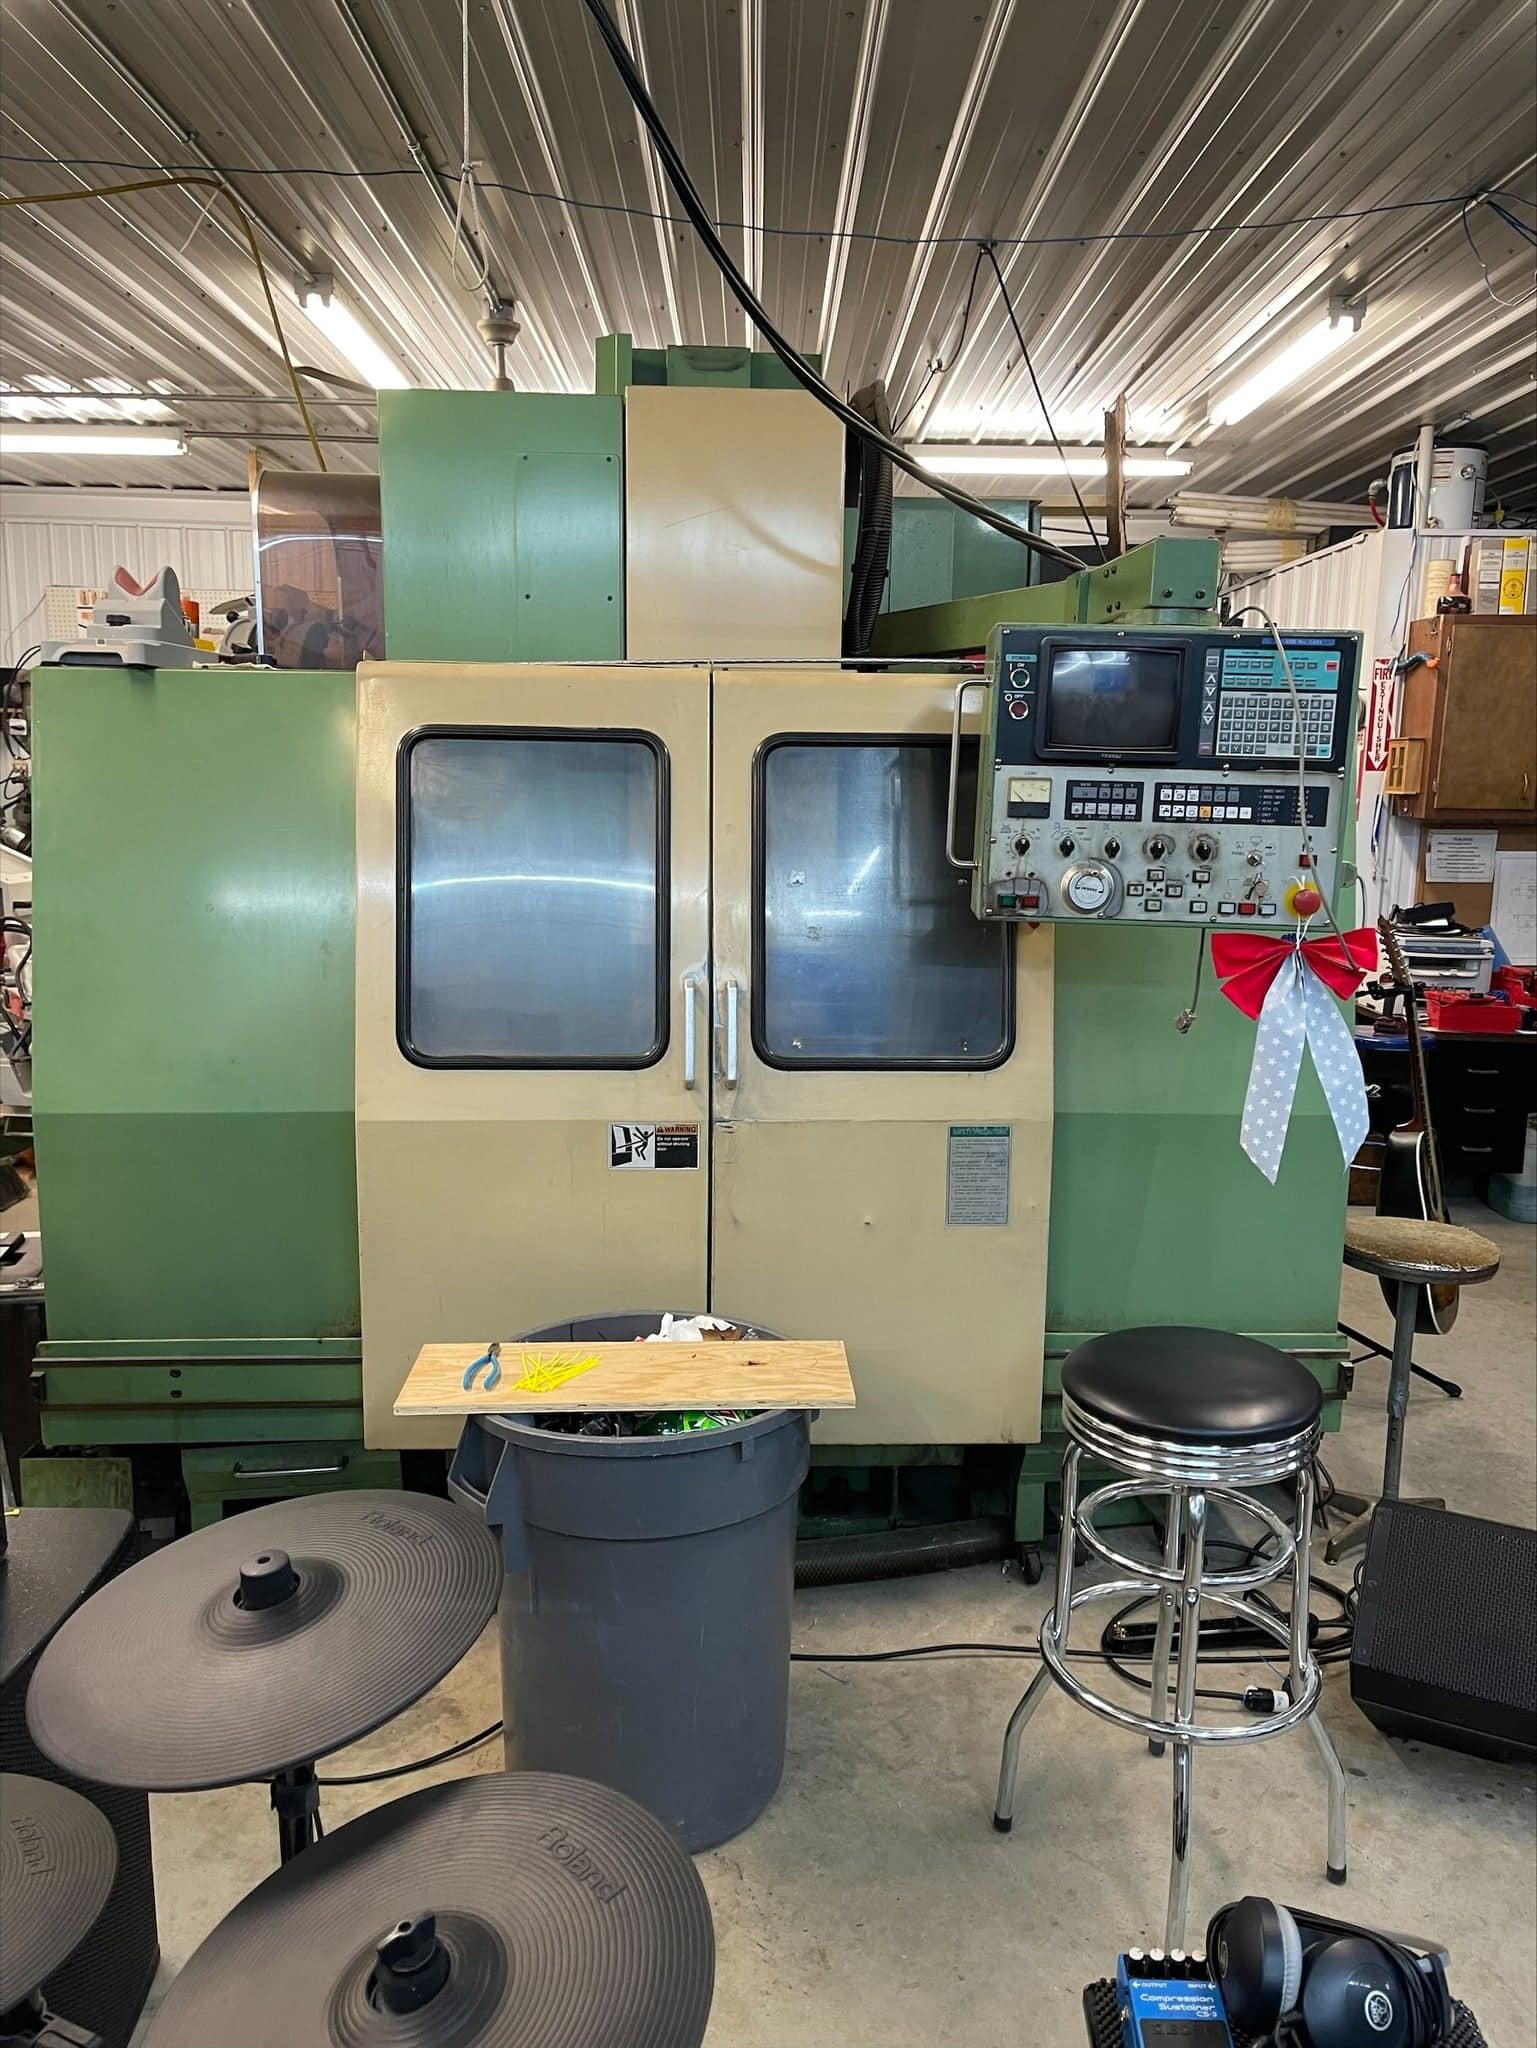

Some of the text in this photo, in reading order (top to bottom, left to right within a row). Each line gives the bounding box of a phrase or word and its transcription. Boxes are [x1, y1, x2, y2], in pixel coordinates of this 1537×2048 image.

[1374, 681, 1386, 762] EXTINGUISHER
[360, 1511, 433, 1545] Roland
[10, 1816, 57, 1876] Roland
[536, 1826, 628, 1904] Roland
[1140, 1993, 1215, 2003] Compression
[1158, 2003, 1215, 2011] Sustainer
